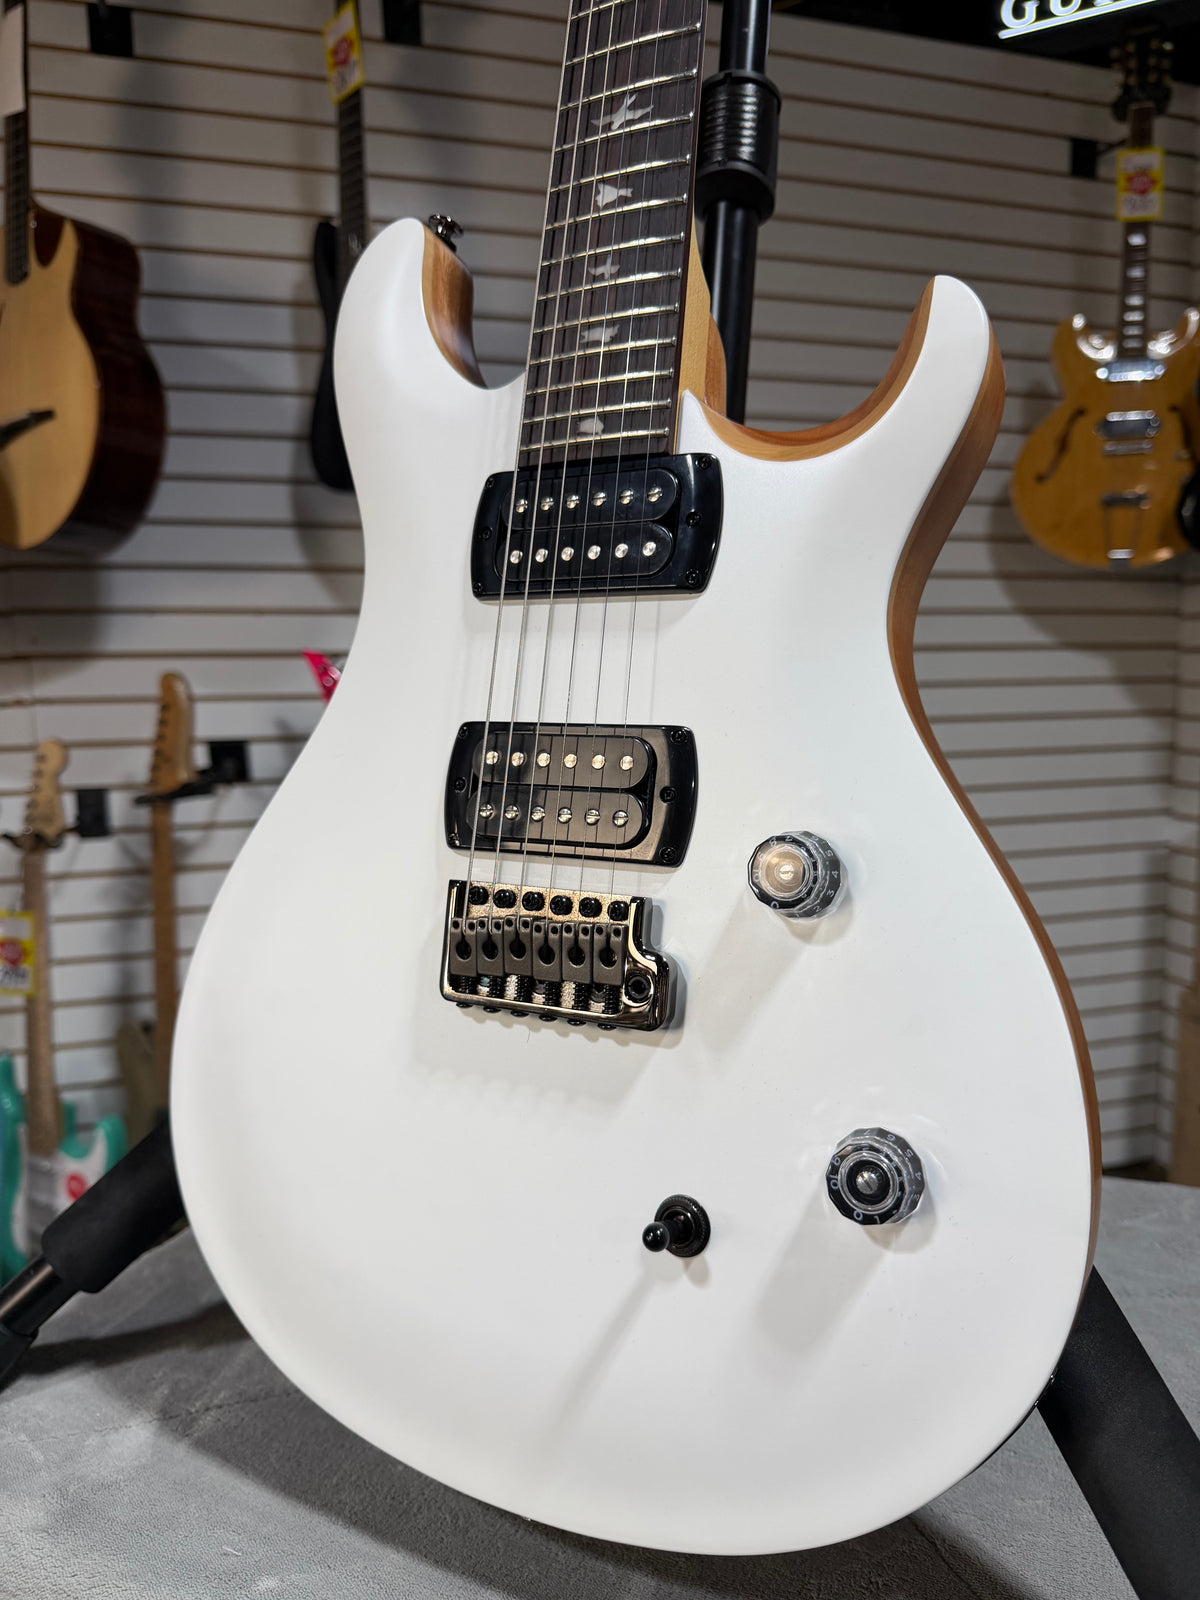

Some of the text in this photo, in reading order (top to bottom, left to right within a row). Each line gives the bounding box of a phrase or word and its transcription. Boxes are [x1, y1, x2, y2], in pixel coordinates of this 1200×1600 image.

[905, 1149, 914, 1157] 5
[914, 1171, 922, 1180] 4
[830, 1174, 839, 1189] 10
[853, 1210, 862, 1220] 0
